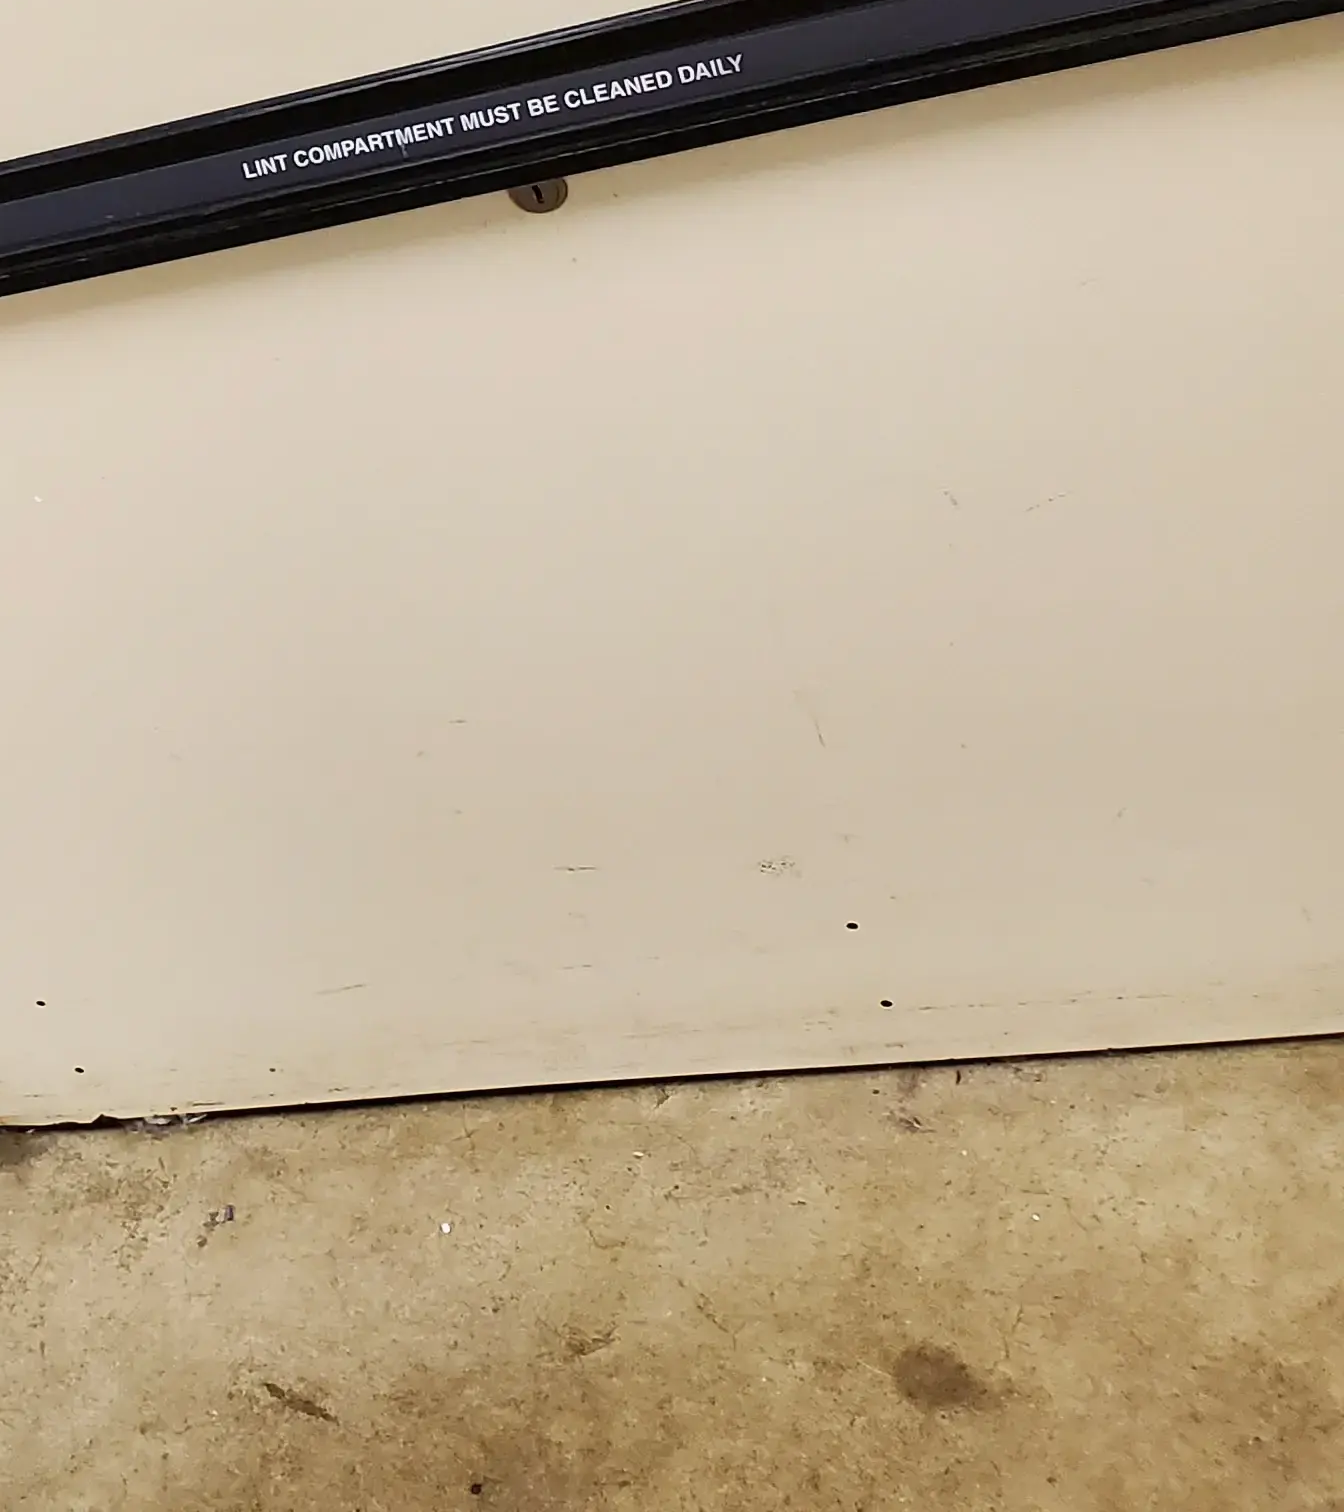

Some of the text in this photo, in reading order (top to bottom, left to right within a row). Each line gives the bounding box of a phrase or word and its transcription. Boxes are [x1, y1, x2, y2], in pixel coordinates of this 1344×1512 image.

[242, 54, 744, 180] LINT COMPARTMENT MUST BE CLEANED DAILY
